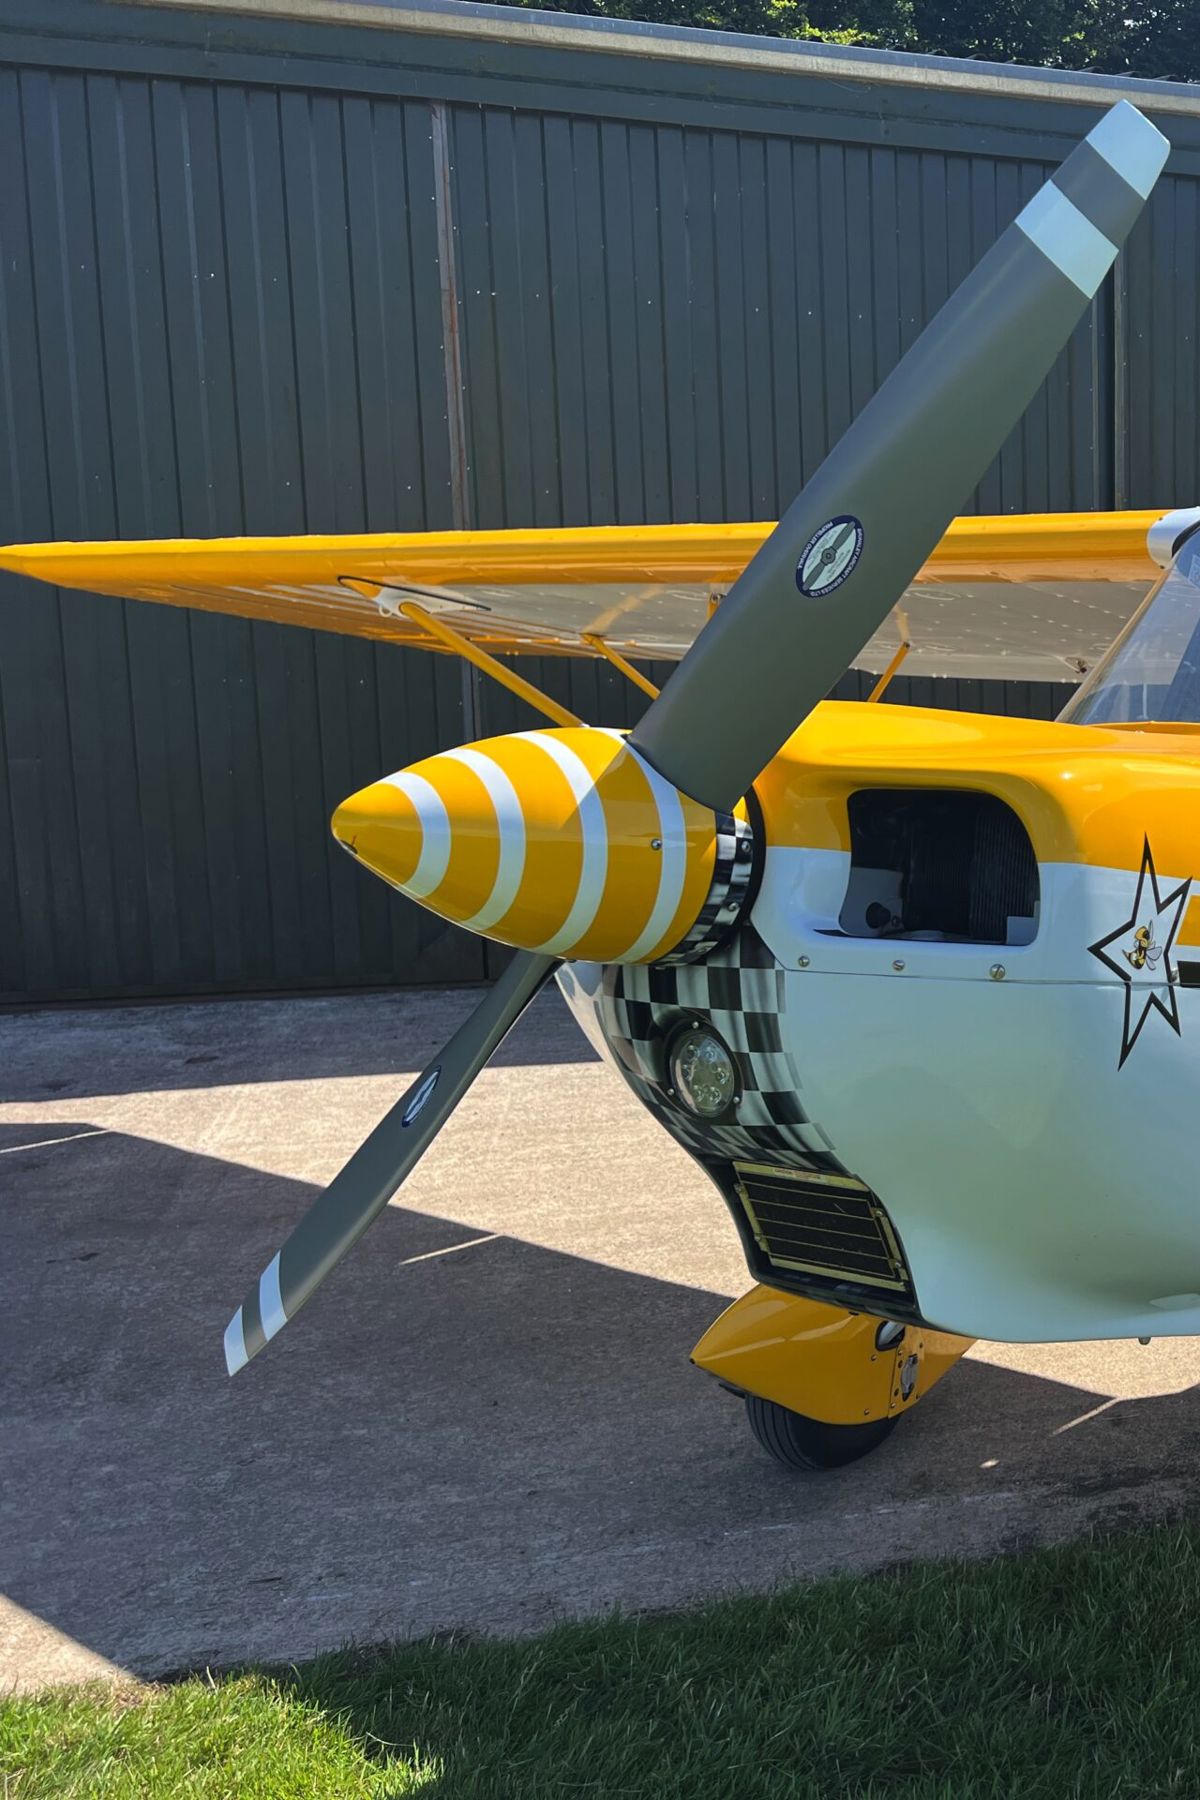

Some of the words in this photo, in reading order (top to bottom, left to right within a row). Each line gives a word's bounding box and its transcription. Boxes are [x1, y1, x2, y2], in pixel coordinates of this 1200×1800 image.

[810, 521, 833, 544] PROPELLER
[842, 554, 857, 578] AIRCRAFT
[821, 576, 843, 595] SERVICES
